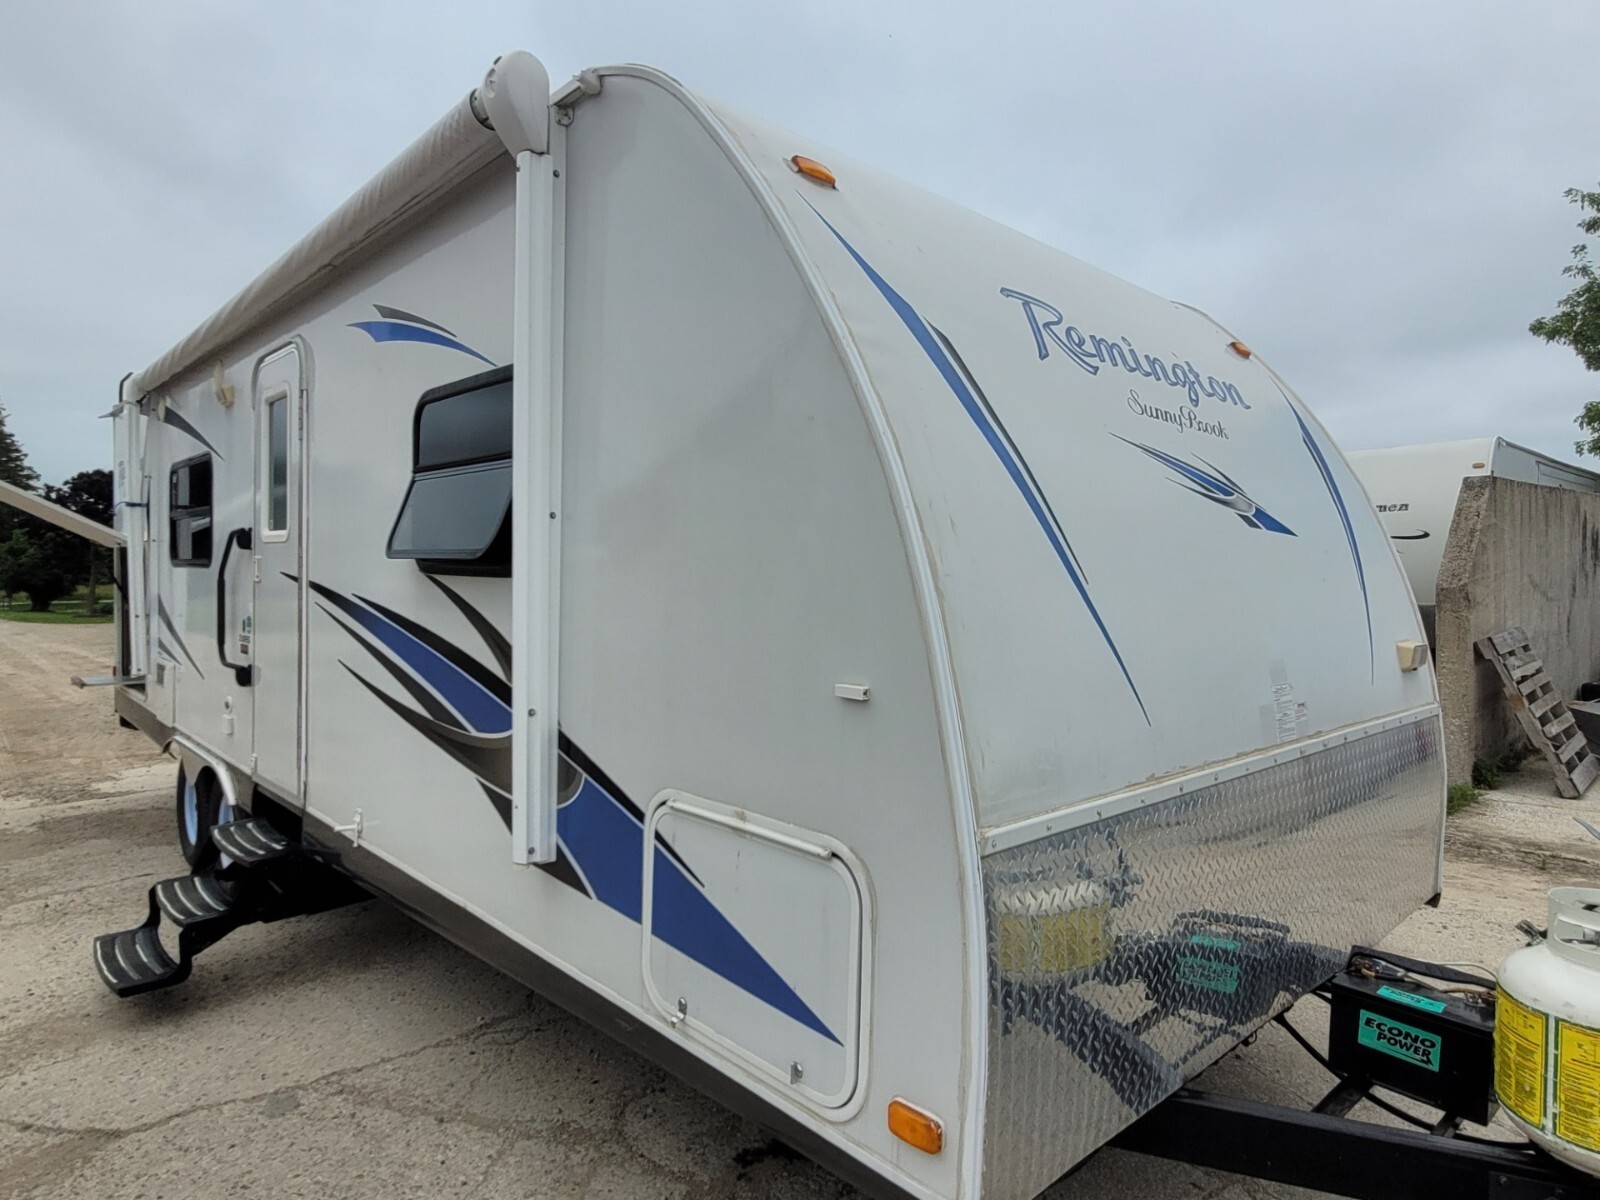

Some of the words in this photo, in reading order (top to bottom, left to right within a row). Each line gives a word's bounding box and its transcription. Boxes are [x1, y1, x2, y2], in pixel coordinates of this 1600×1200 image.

[1000, 287, 1251, 409] Remington
[1127, 389, 1229, 439] SunnyBrook
[1364, 1017, 1437, 1049] ECONO
[1377, 1031, 1432, 1059] POWER
